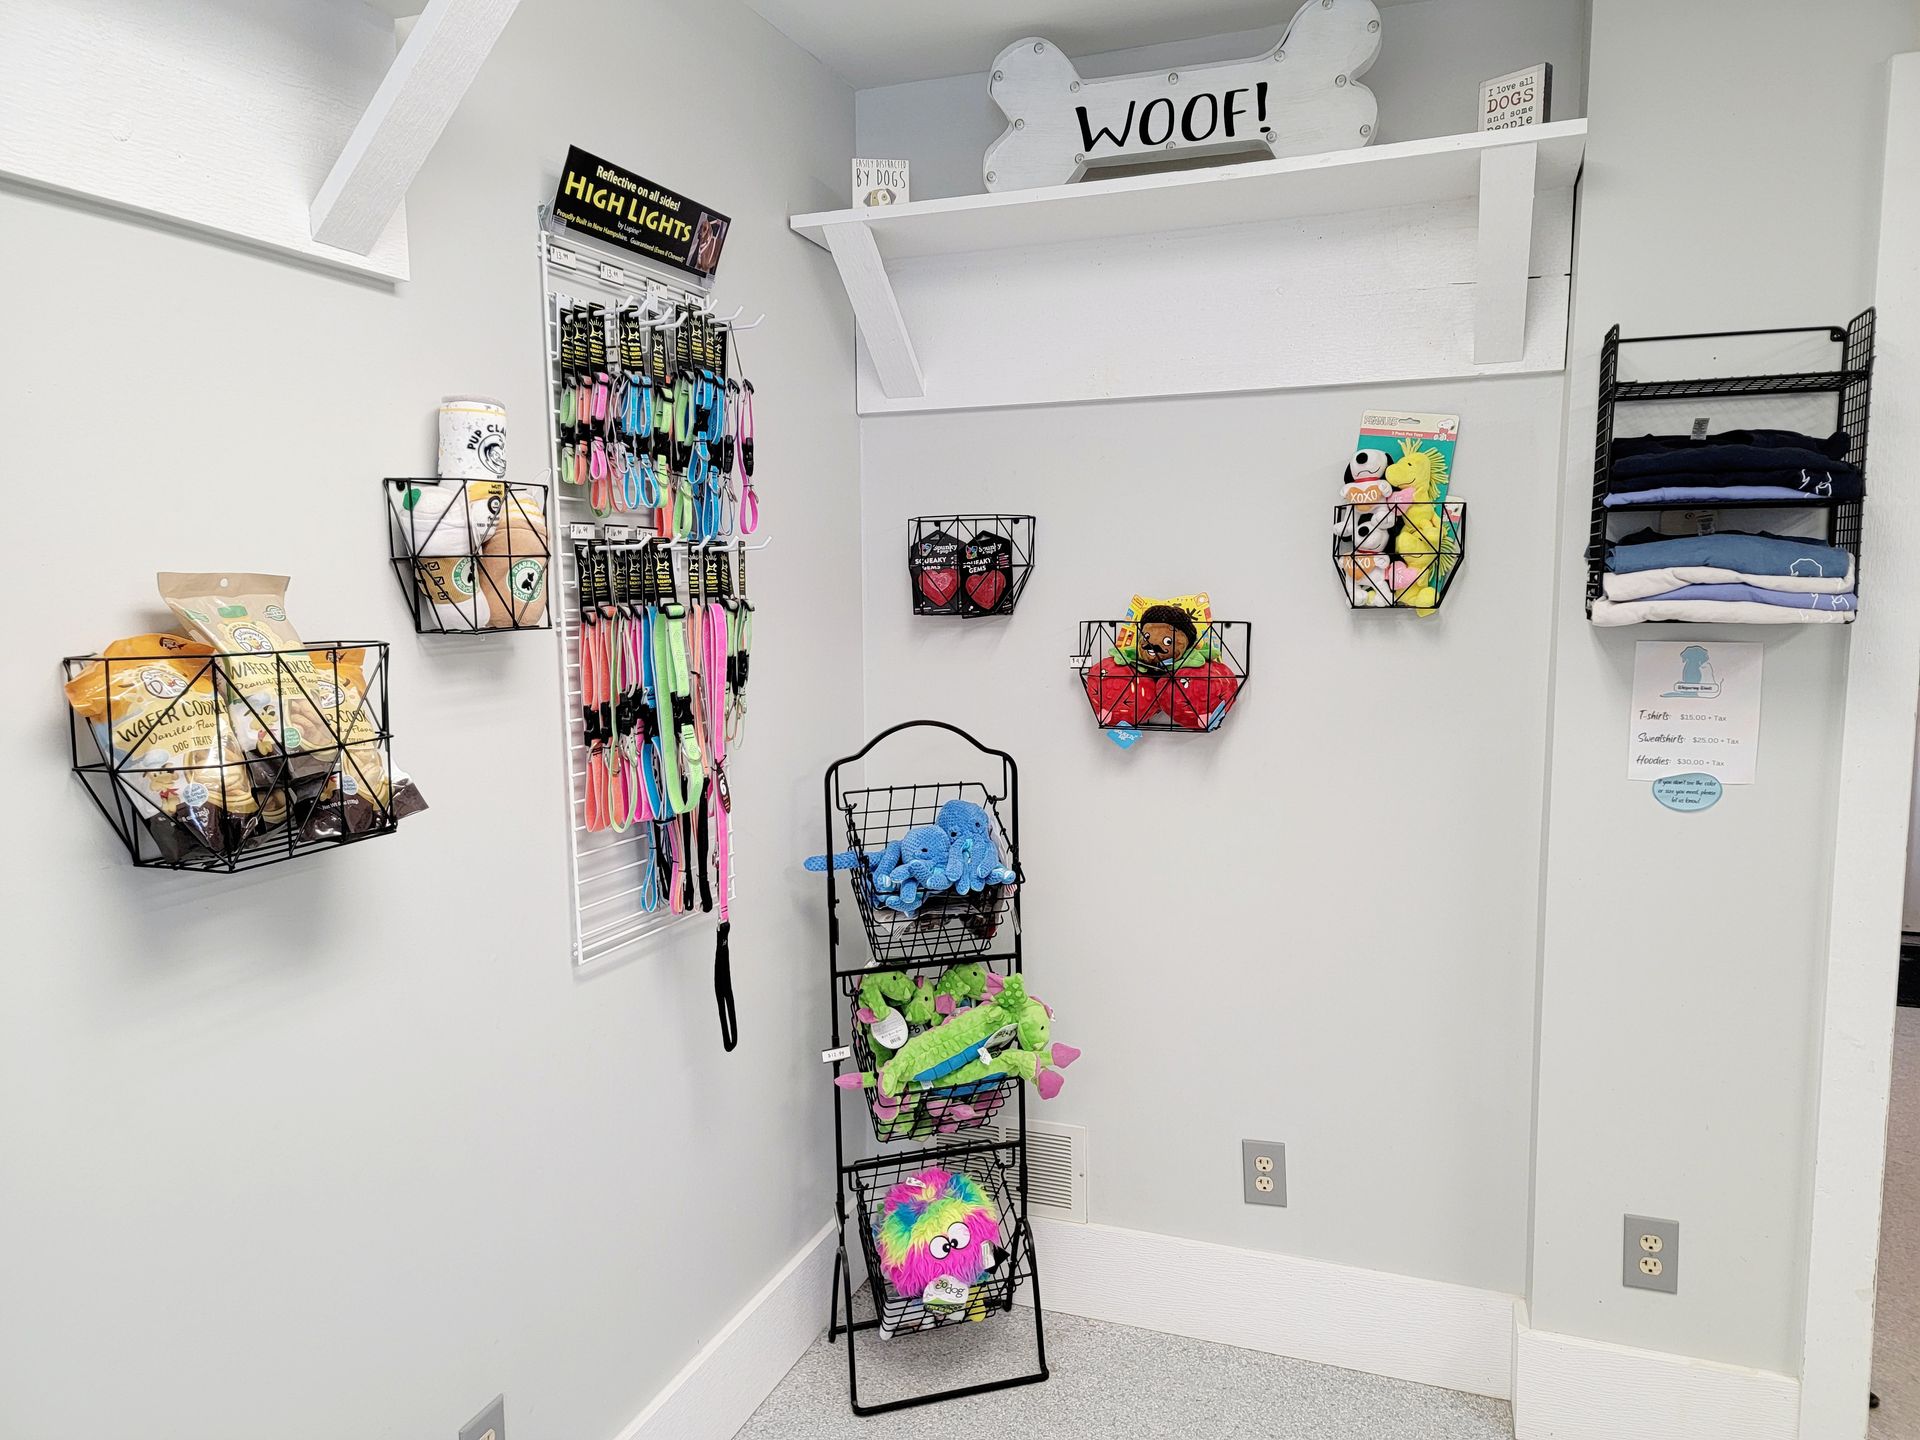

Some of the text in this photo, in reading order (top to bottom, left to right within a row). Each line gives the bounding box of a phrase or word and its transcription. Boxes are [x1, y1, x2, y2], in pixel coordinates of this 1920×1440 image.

[1488, 76, 1534, 97] I love all
[1487, 88, 1534, 114] DOGS
[1075, 81, 1271, 152] WOOF!
[1487, 105, 1533, 124] and some
[856, 159, 906, 169] EASILY DISTRACTED
[596, 165, 681, 211] Reflective on all sides!
[856, 168, 906, 188] BY DOGS
[565, 171, 692, 242] HIGH LIGHTS
[556, 208, 575, 223] Proudly
[575, 215, 587, 226] Built
[592, 222, 603, 232] New
[617, 221, 624, 230] by
[467, 430, 483, 450] PUP
[1350, 489, 1378, 503] XOXO
[230, 661, 273, 680] WAFER
[117, 706, 180, 742] WAFER
[148, 724, 195, 745] Vanilla
[173, 735, 213, 753] DOG TREATS
